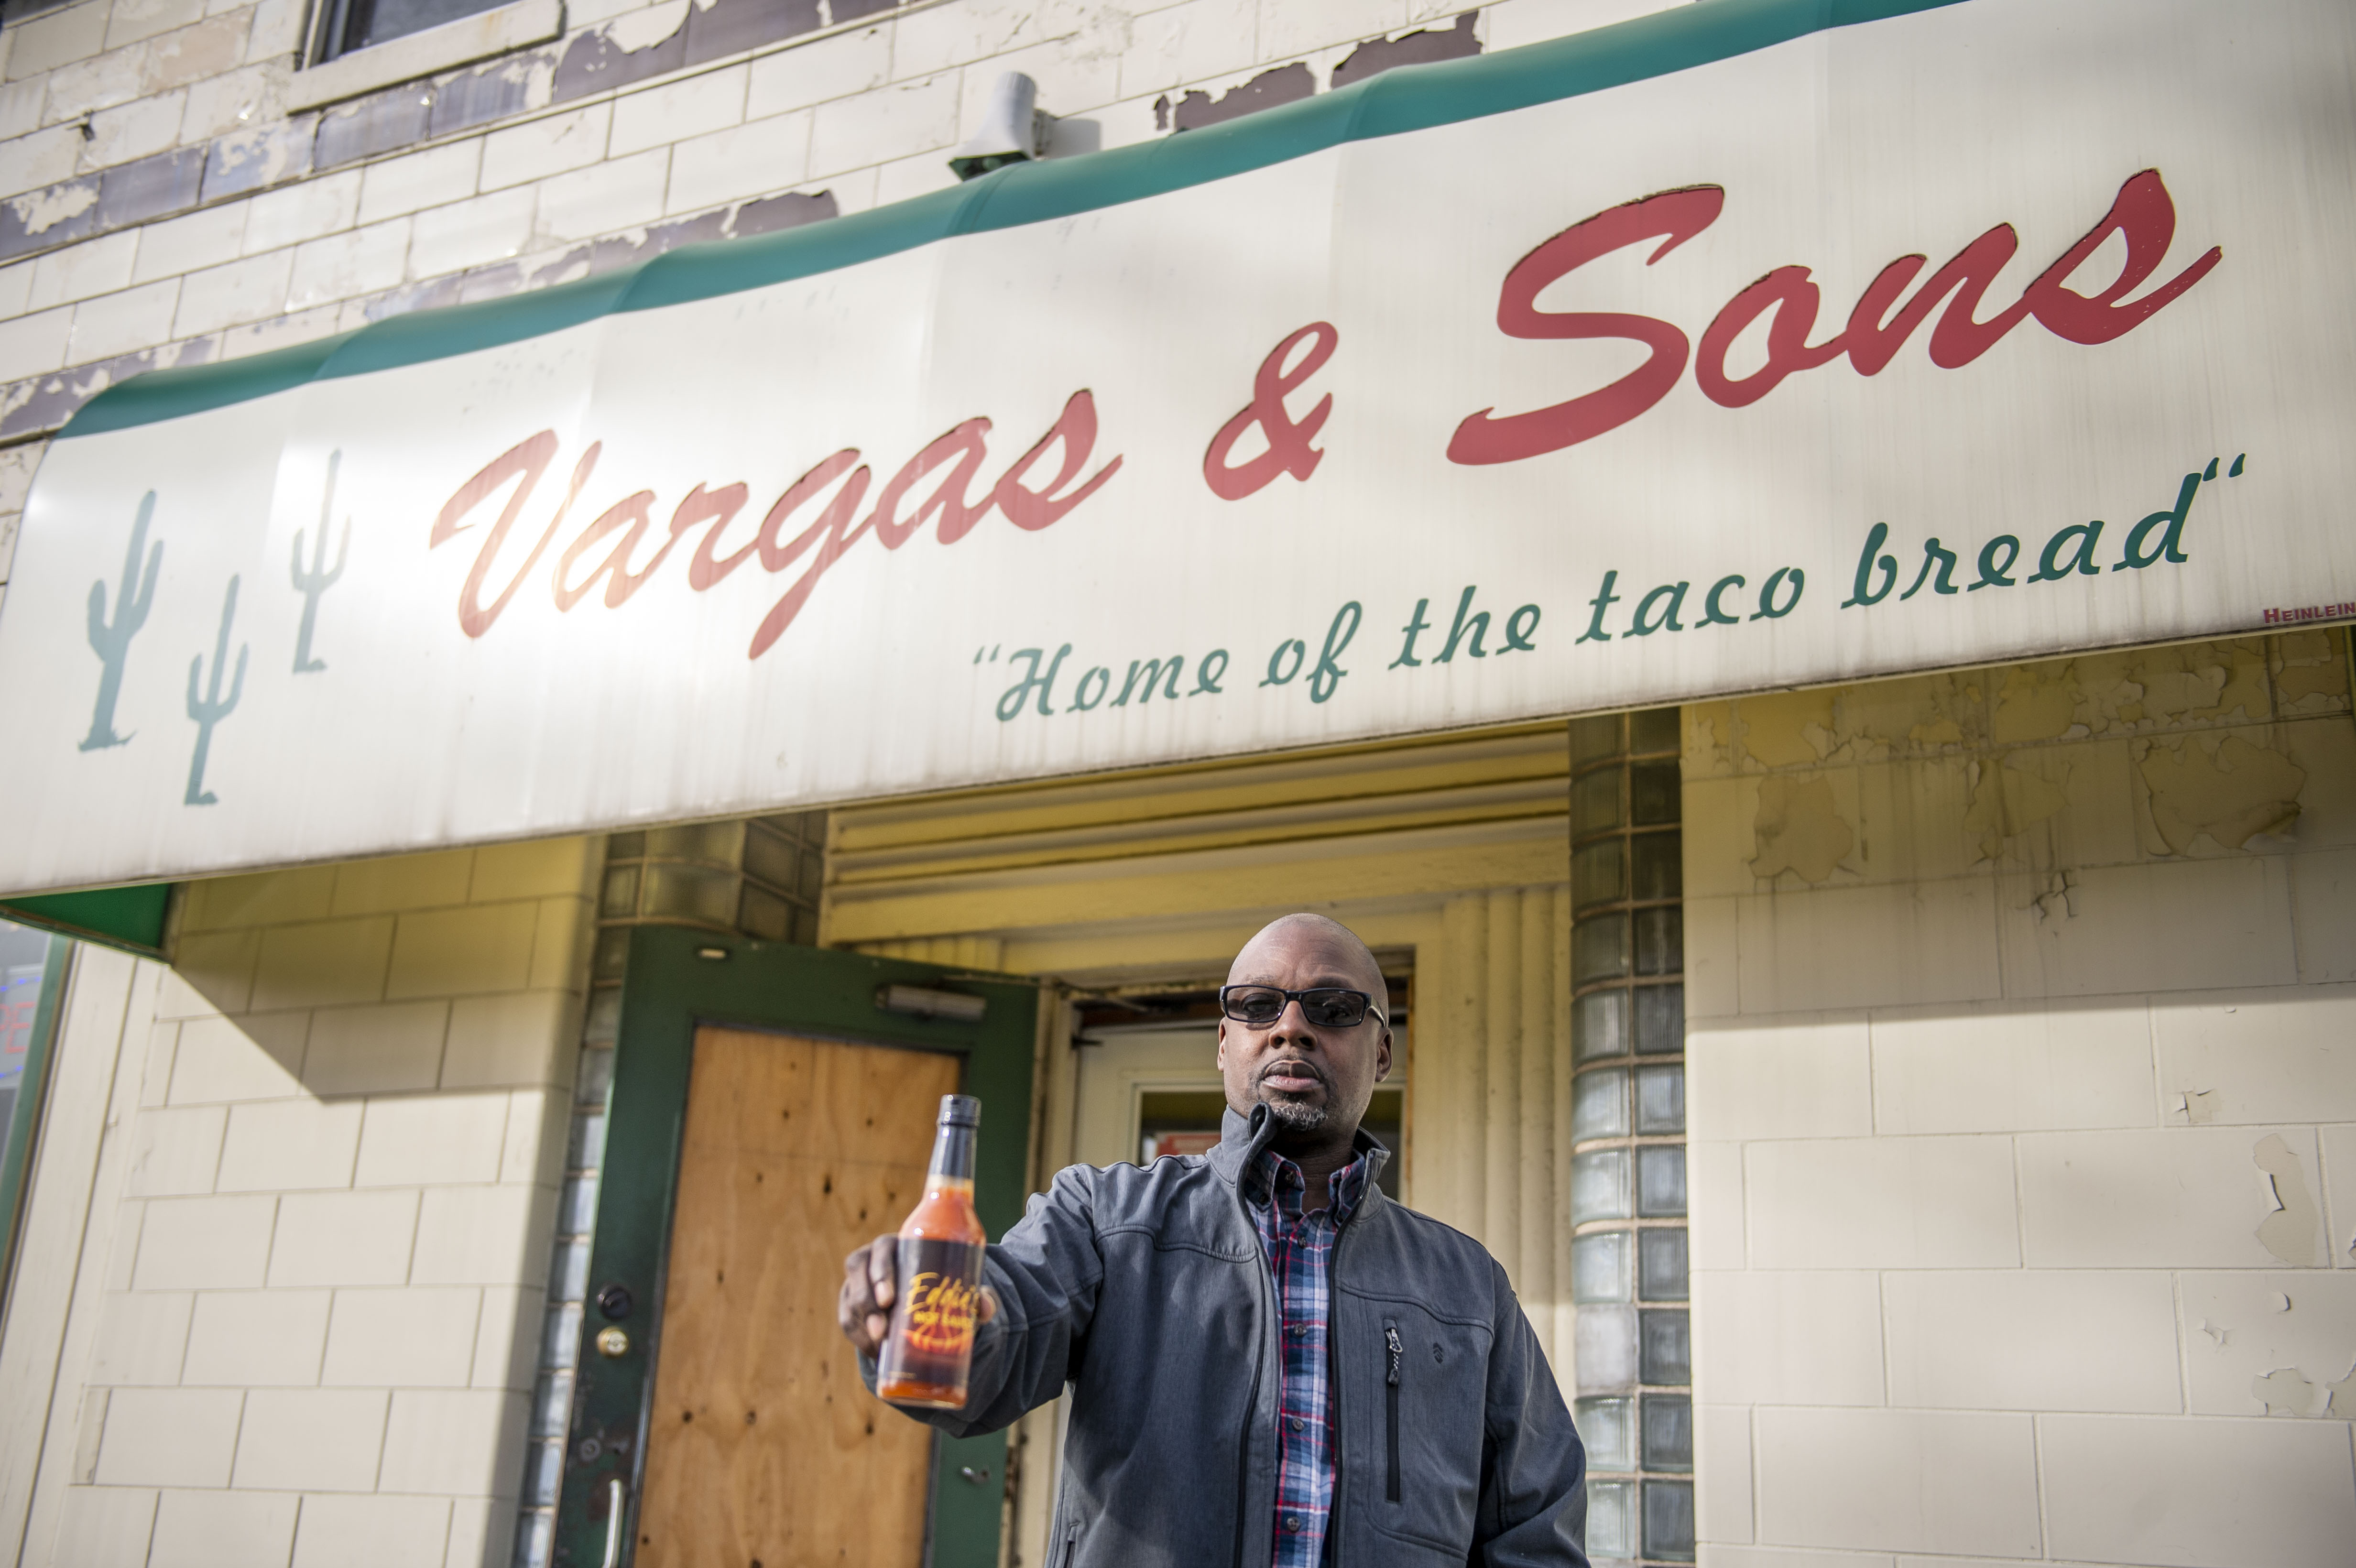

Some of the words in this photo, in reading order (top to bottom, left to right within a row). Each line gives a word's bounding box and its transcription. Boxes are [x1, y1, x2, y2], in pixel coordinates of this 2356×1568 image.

[429, 388, 1123, 660] Vargas
[1203, 321, 1338, 501] &
[1446, 168, 2222, 465] Sons
[1259, 600, 1363, 704] of
[1388, 585, 1541, 669] the
[1575, 570, 1805, 645] taco
[2263, 601, 2356, 624] HEINLEIN
